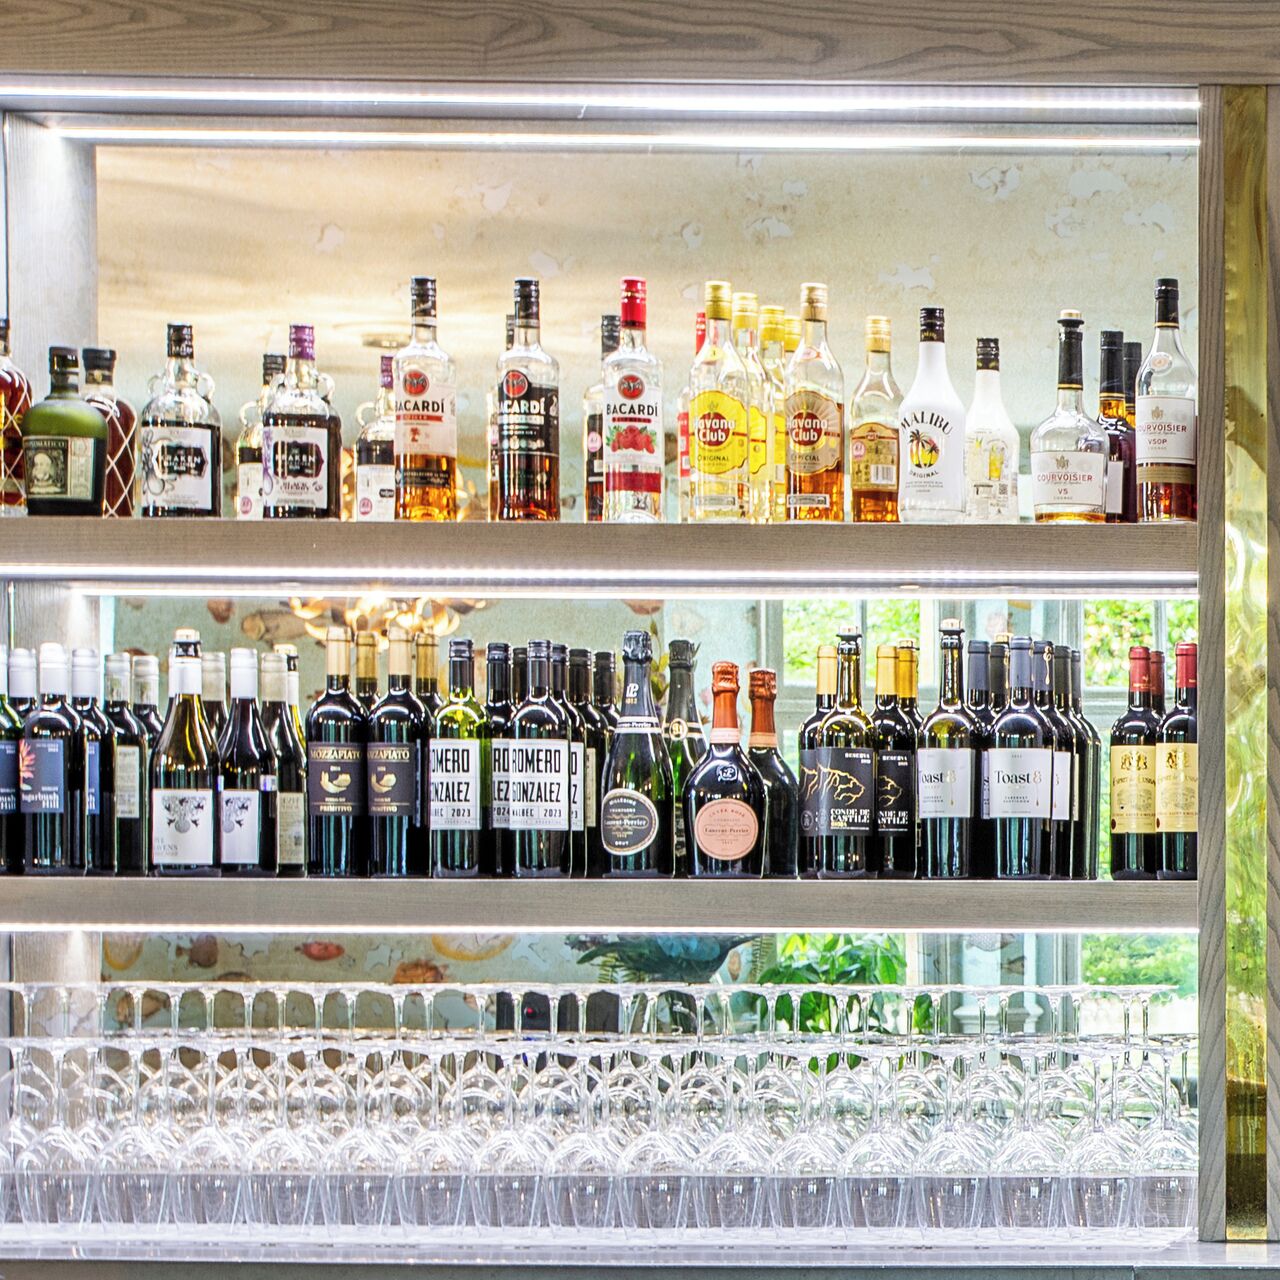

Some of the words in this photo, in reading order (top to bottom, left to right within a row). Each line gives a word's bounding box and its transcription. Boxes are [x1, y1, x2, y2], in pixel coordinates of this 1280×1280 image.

[606, 402, 658, 416] BACARDÍ
[901, 411, 952, 435] MALIBU
[699, 429, 726, 442] Club
[792, 429, 818, 442] Club
[1037, 473, 1093, 482] COURVOISIER
[512, 749, 561, 773] ROMERO
[994, 770, 1030, 783] Toast
[451, 808, 471, 817] 2023
[543, 809, 562, 817] 2023
